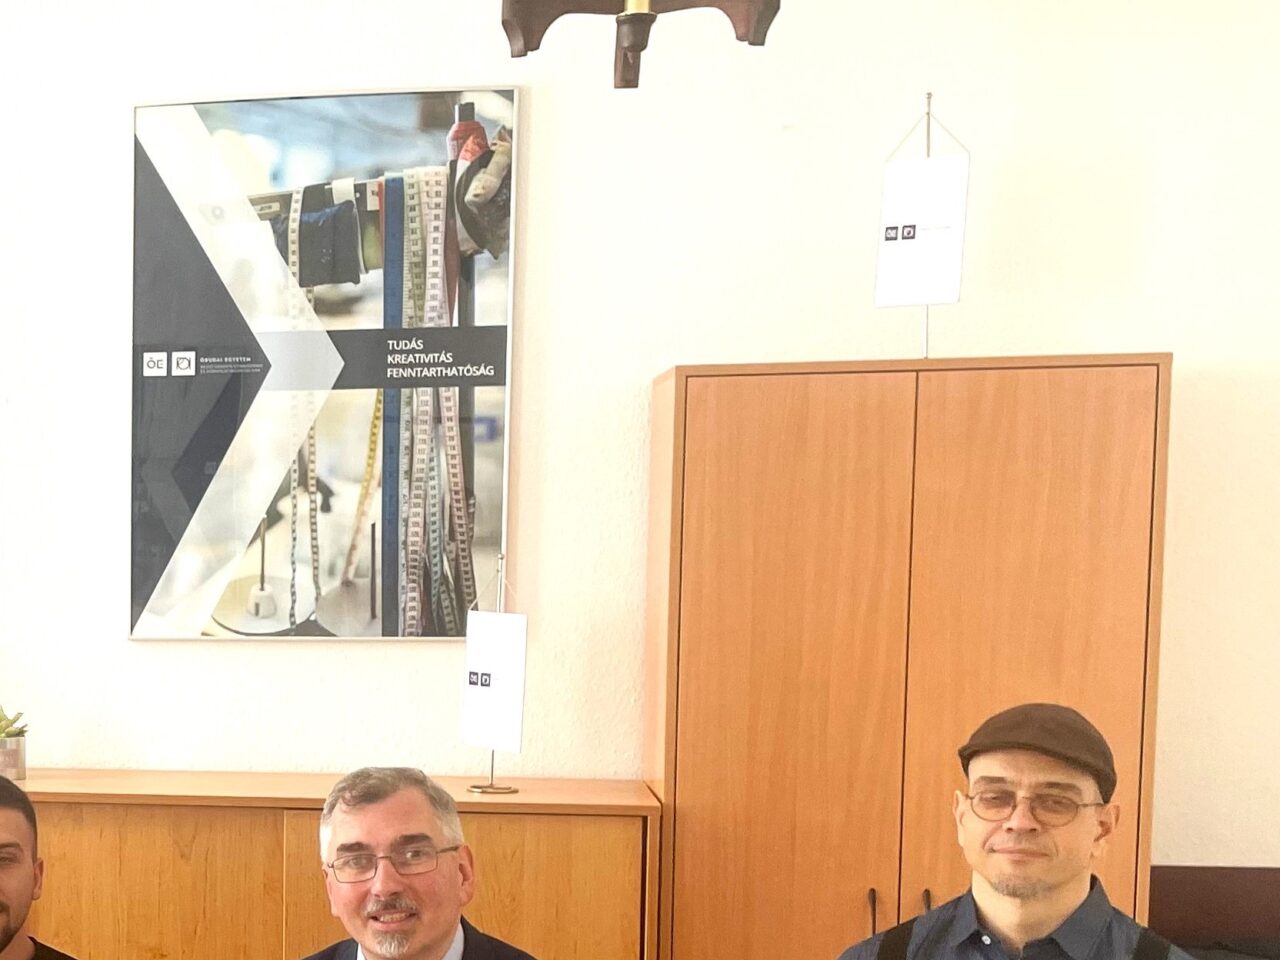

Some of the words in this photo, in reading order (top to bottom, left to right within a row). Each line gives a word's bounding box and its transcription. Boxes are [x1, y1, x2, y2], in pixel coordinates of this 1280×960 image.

[386, 337, 424, 351] TUDÁS
[387, 350, 453, 364] KREATIVITÁS
[387, 363, 495, 378] FENNTARTHATÓSÁG
